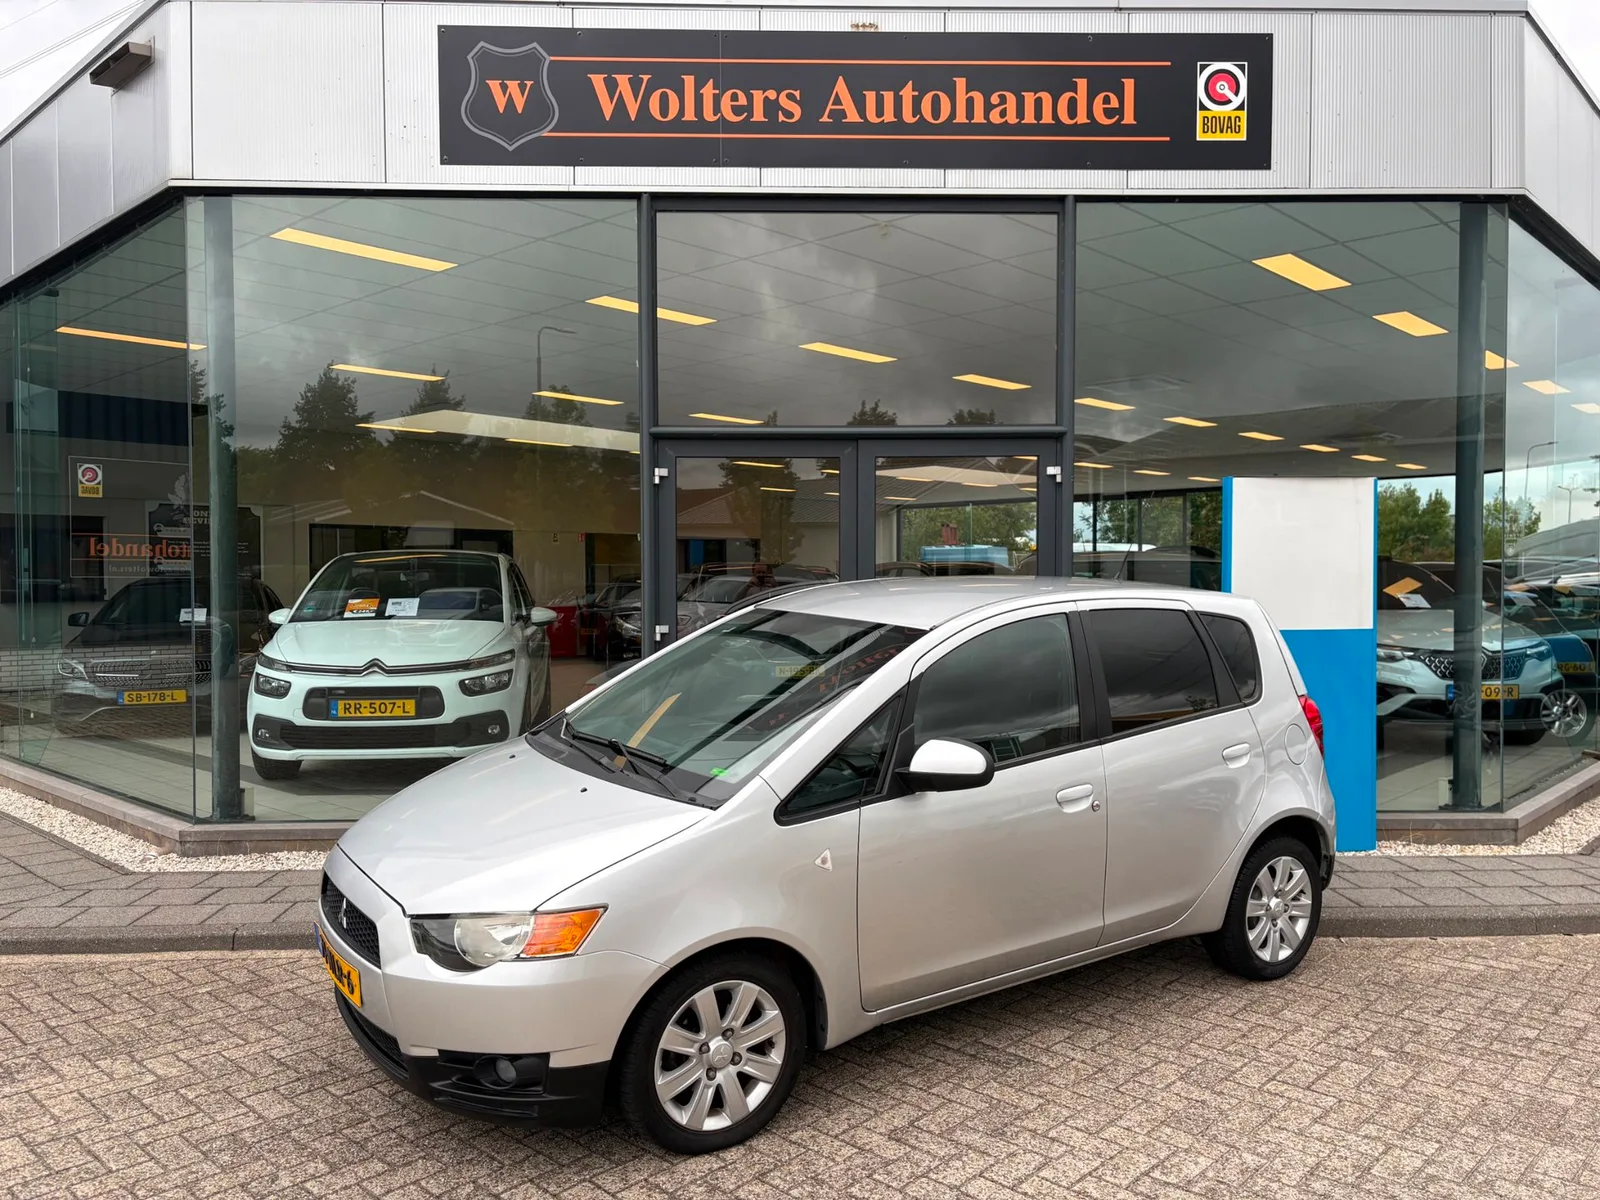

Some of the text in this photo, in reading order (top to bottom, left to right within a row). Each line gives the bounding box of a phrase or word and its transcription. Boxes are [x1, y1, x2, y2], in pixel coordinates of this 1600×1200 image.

[485, 79, 534, 114] W
[587, 74, 1138, 125] Wolters Autohandel
[1202, 115, 1242, 134] BOVAG
[127, 692, 177, 702] SB-178-L
[1481, 687, 1514, 698] -09-R
[343, 702, 410, 714] RR-507-L
